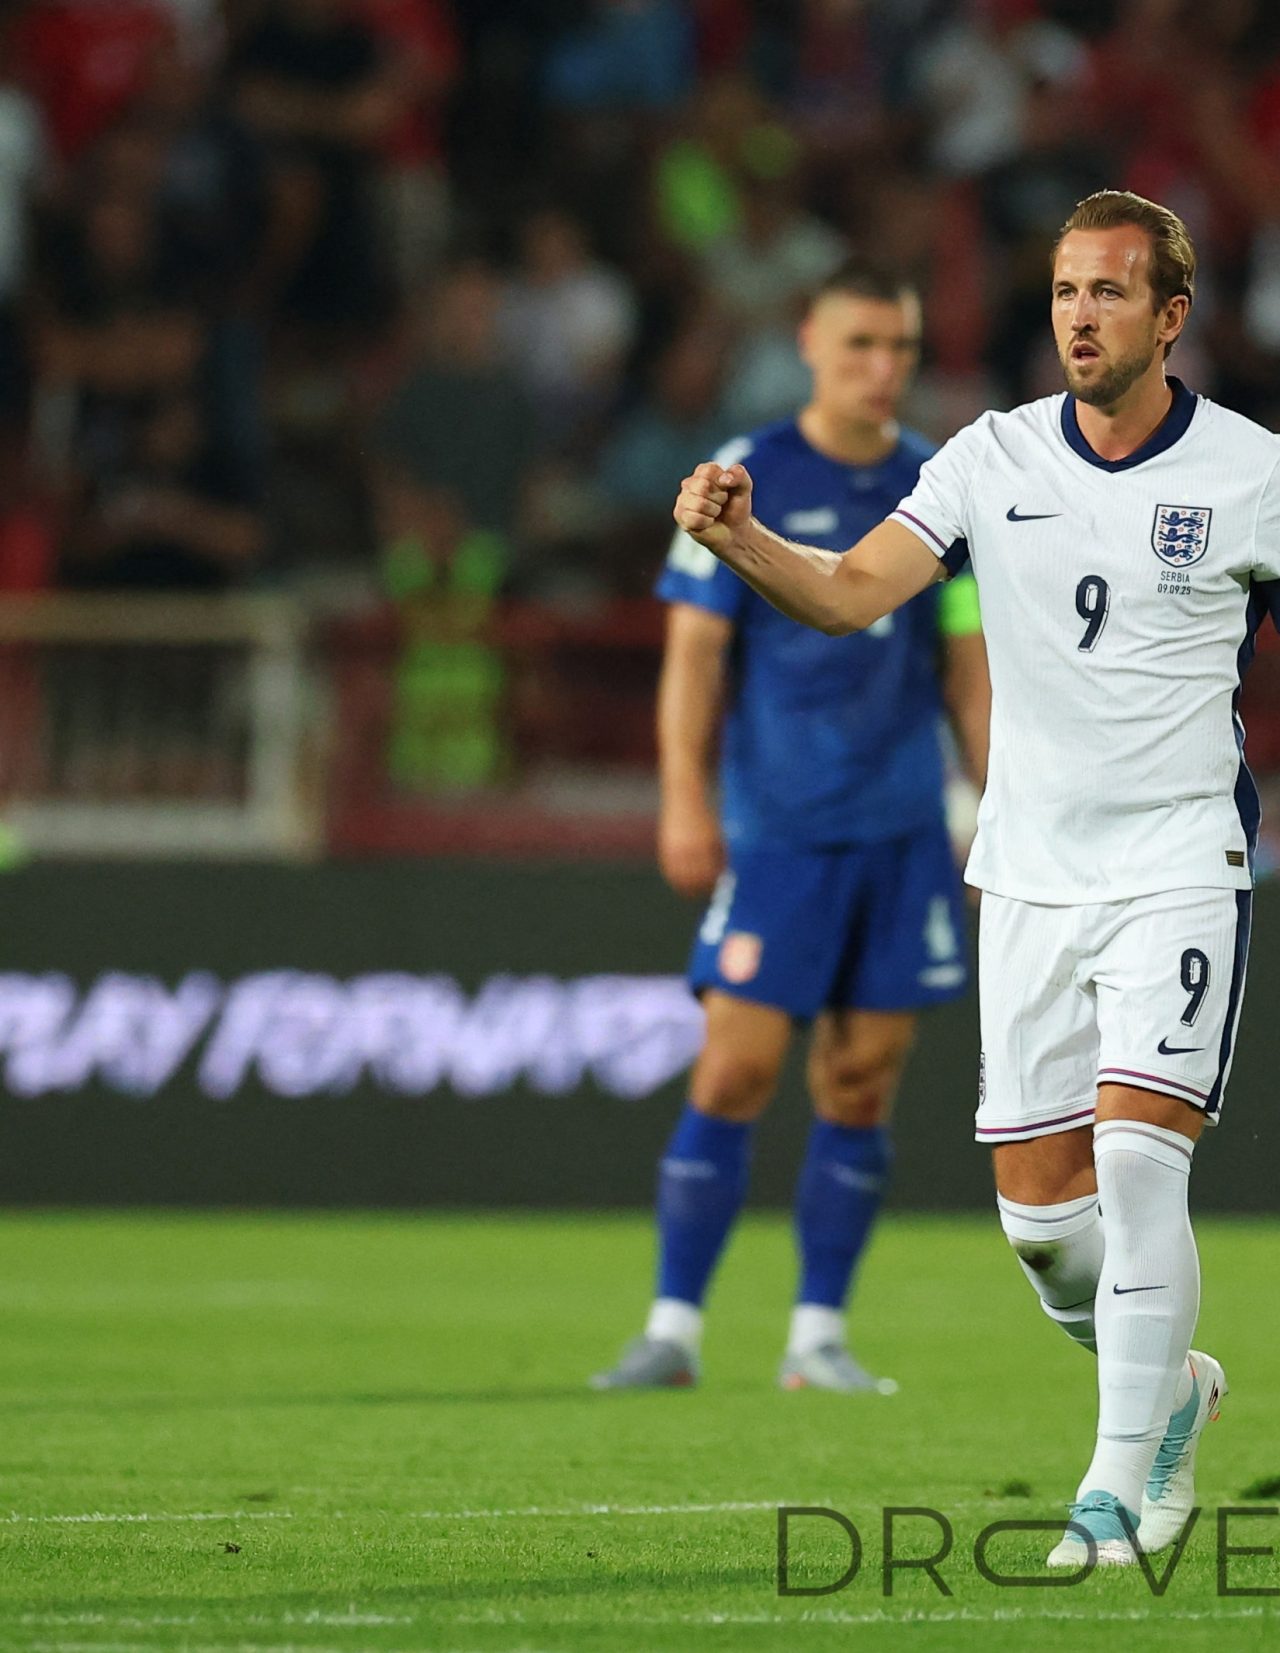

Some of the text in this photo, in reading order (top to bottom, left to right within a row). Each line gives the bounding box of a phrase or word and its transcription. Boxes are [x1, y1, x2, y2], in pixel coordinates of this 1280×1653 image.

[1157, 583, 1192, 596] 09.09.25
[1160, 570, 1191, 583] SERBIA
[1075, 574, 1112, 654] 9
[1180, 947, 1212, 1028] 9
